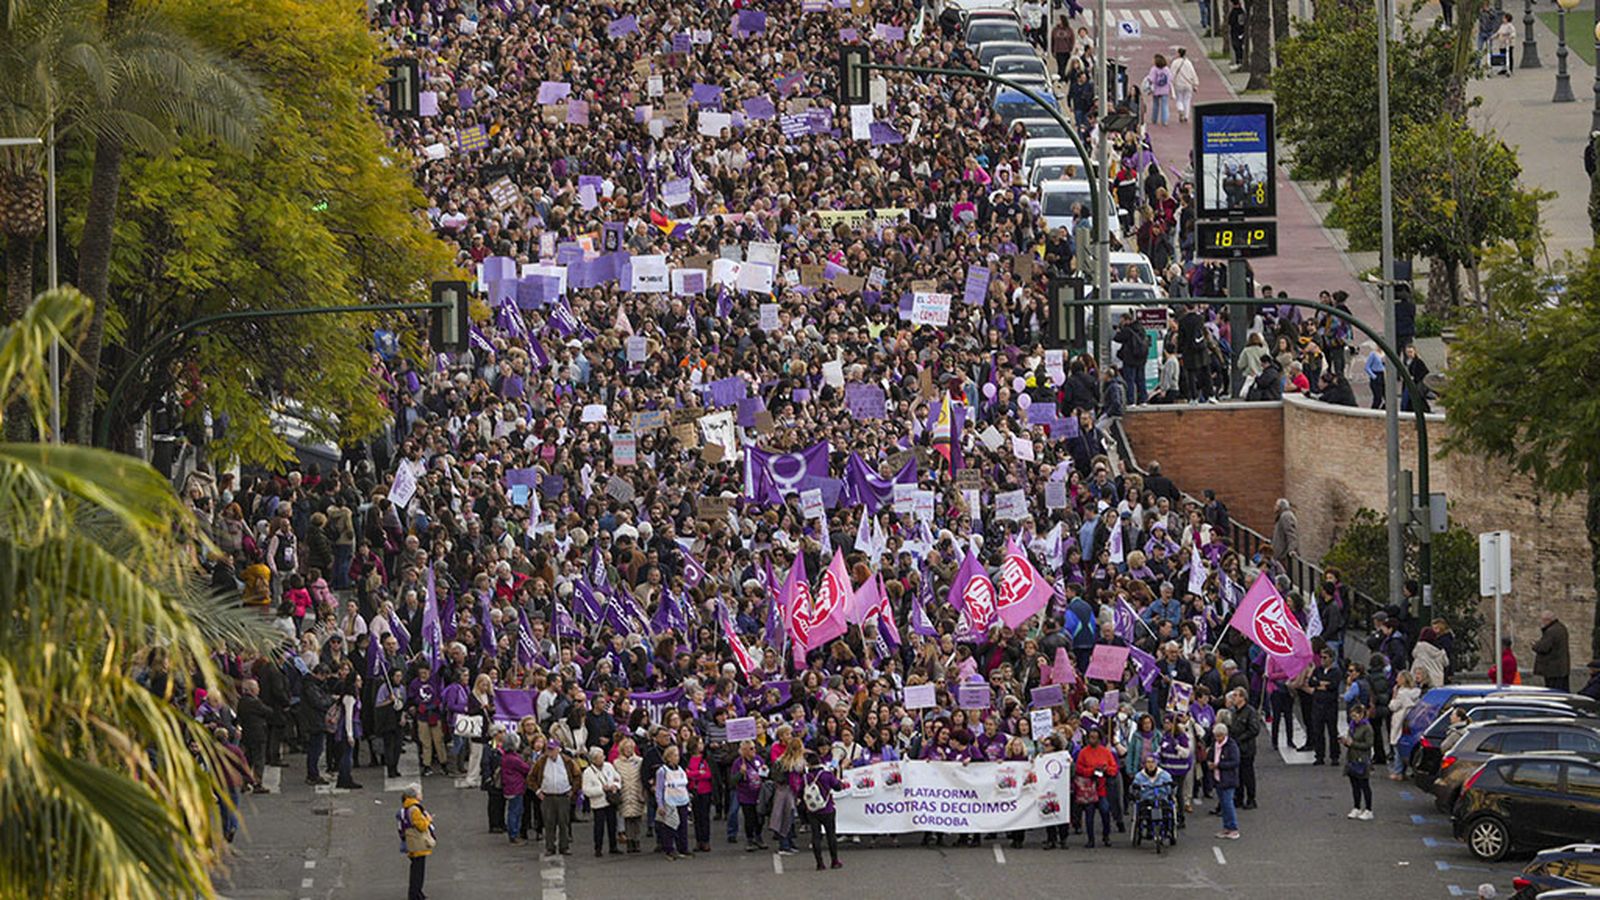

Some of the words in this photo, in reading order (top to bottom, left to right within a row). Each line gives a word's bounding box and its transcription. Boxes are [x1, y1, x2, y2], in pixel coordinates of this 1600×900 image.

[1215, 230, 1233, 247] 18
[999, 557, 1032, 590] UGT
[903, 787, 978, 799] PLATAFORMA
[864, 800, 937, 815] NOSOTRAS
[940, 799, 1017, 814] DECIDIMOS
[912, 814, 969, 826] CÓRDOBA
